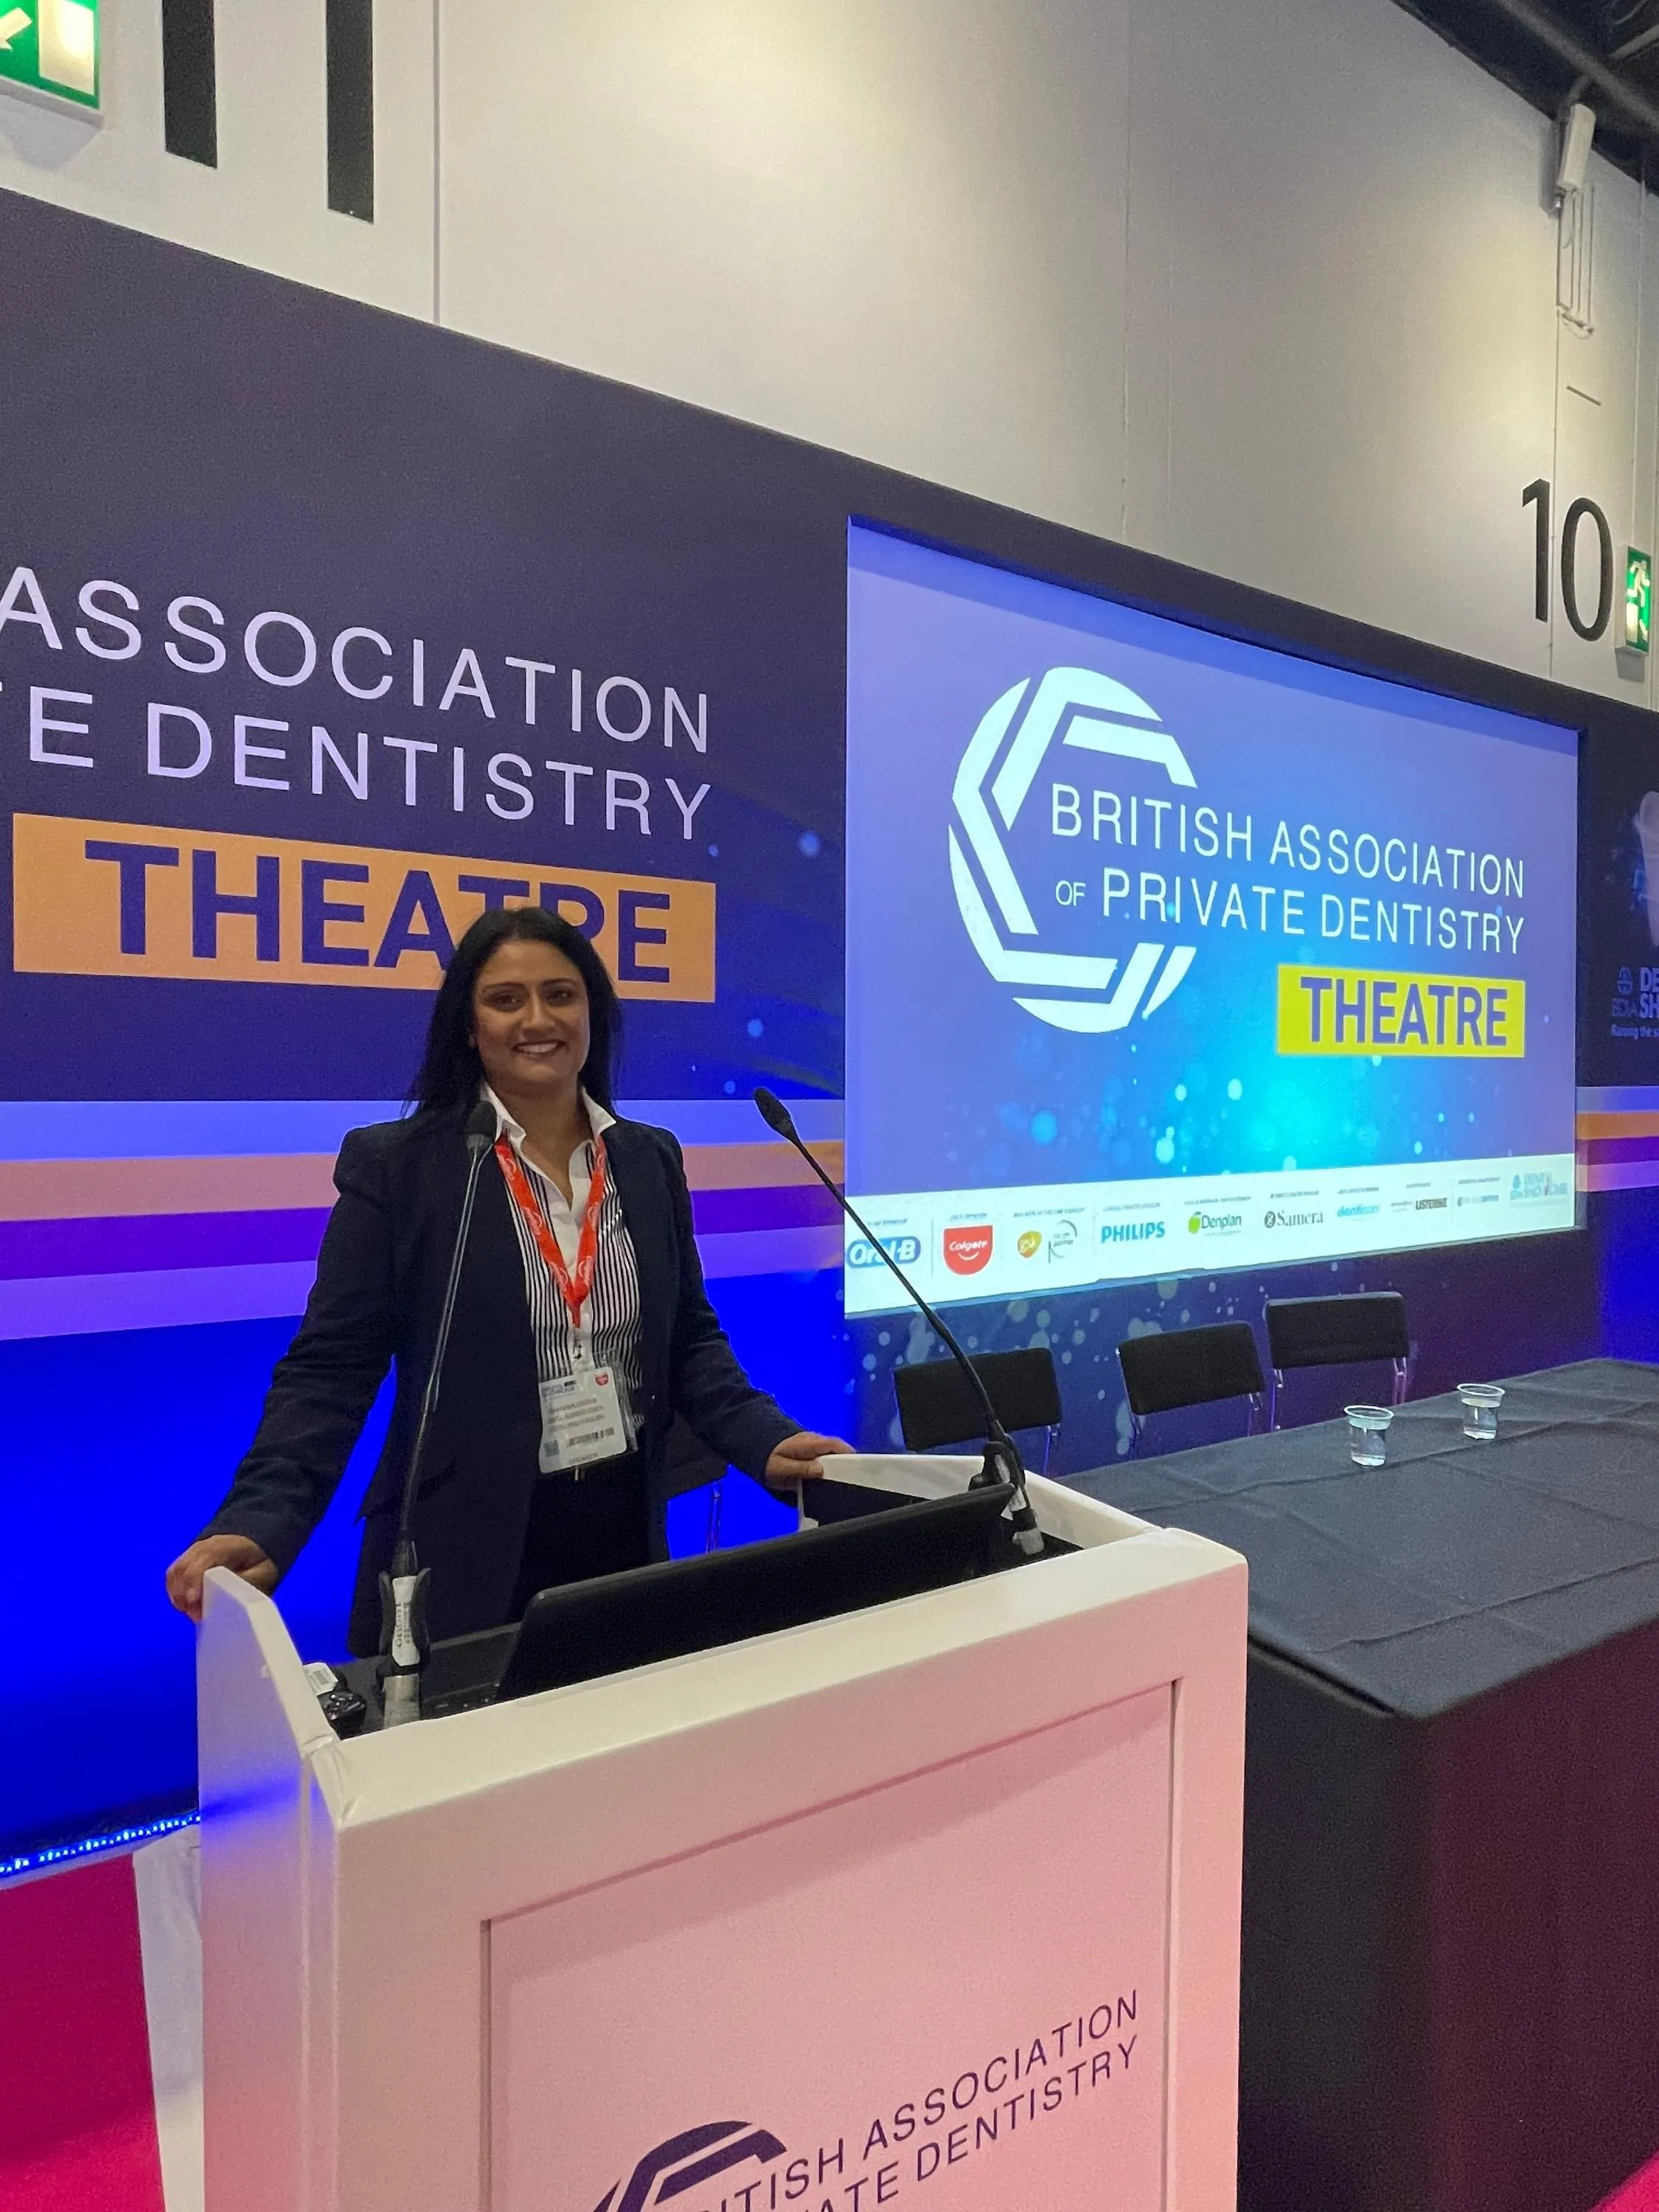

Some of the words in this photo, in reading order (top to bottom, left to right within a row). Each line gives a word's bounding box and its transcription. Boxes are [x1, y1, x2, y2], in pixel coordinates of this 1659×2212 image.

[1522, 479, 1613, 641] 10
[0, 566, 708, 754] ASSOCIATION
[147, 701, 711, 841] DENTISTRY
[1051, 782, 1252, 862] BRITISH
[1270, 820, 1523, 898] ASSOCIATION
[1055, 880, 1086, 906] OF
[1103, 867, 1305, 935] PRIVATE
[1321, 894, 1524, 954] DENTISTRY
[1300, 976, 1509, 1046] THEATRE
[949, 1240, 988, 1252] Colgate
[1101, 1221, 1166, 1244] PHILIPS
[1201, 1214, 1242, 1231] Denplan
[863, 1989, 1137, 2160] ASSOCIATION
[917, 2034, 1137, 2182] DENTISTRY
